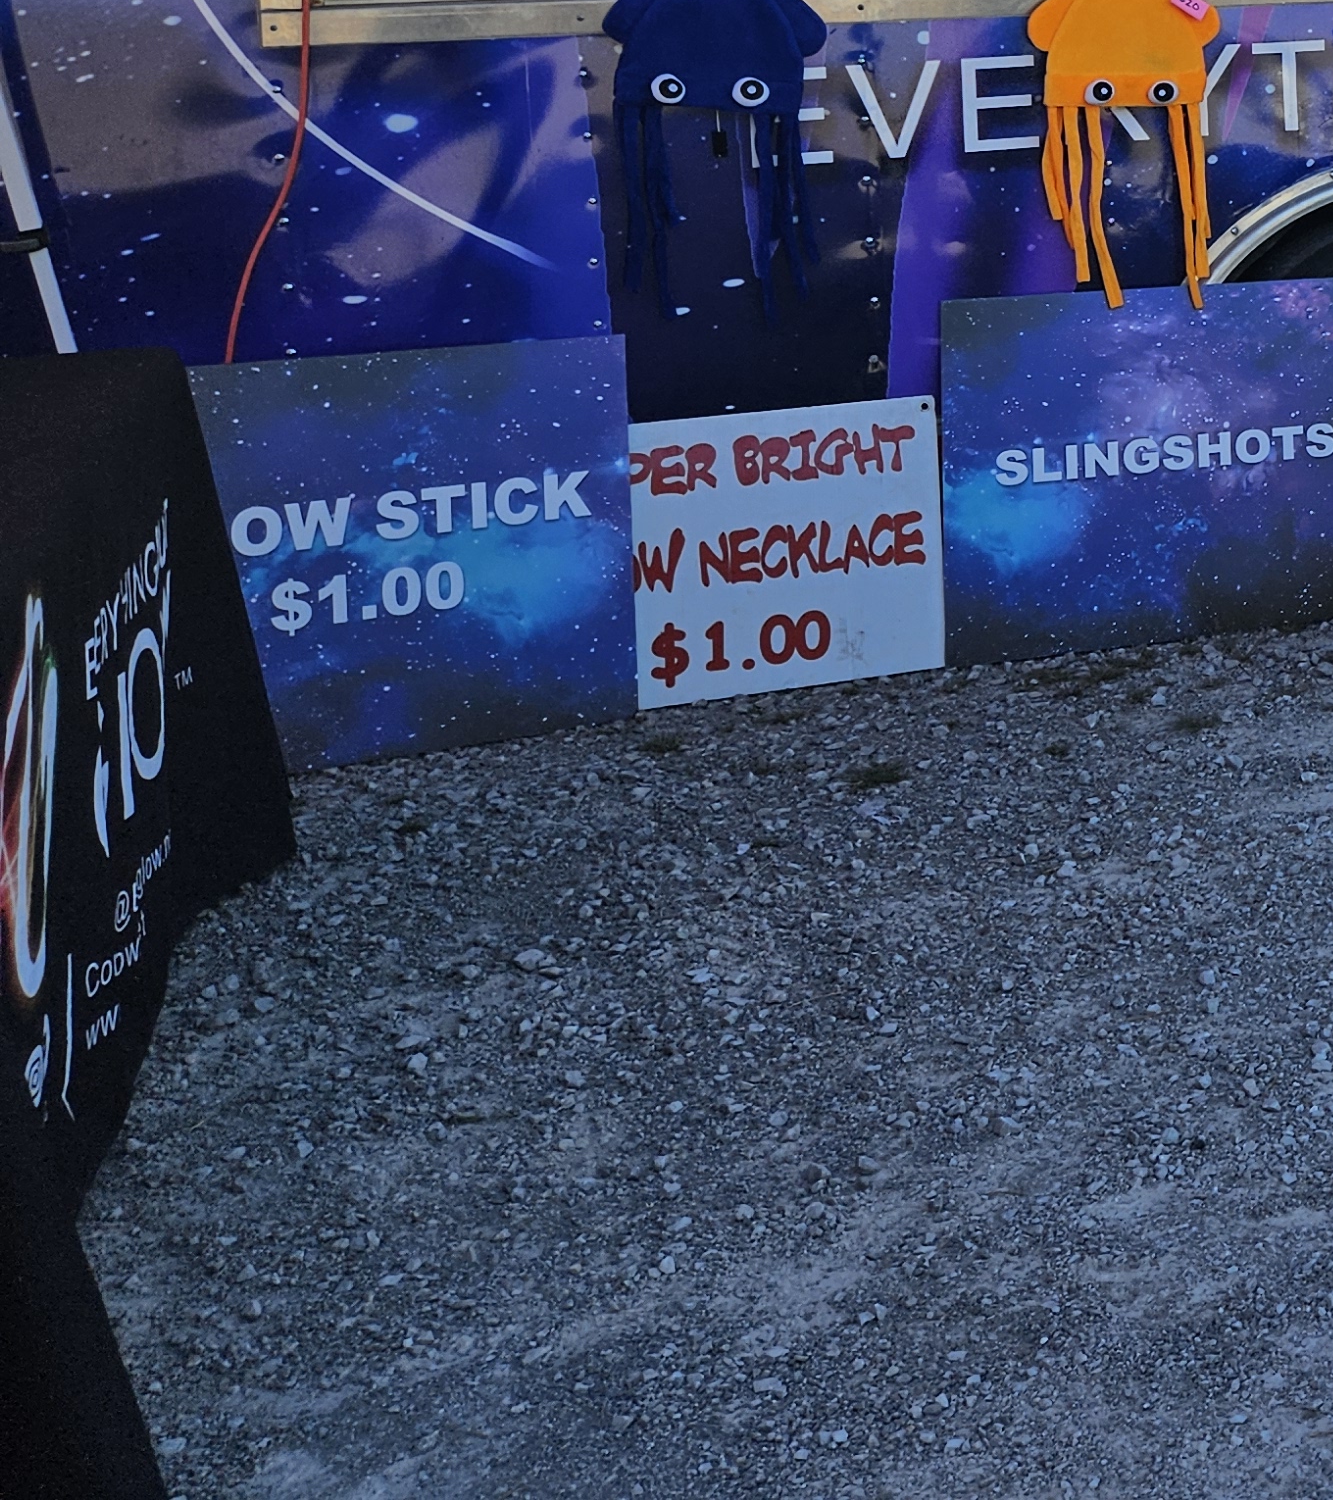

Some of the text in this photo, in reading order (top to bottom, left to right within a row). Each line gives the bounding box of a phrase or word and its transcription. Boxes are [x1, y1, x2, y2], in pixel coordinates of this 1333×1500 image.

[629, 424, 915, 496] PER BRIGHT
[231, 470, 592, 556] OW STICK
[699, 511, 927, 587] NECKLACE
[270, 561, 466, 637] $1.00
[651, 610, 831, 688] $1.00
